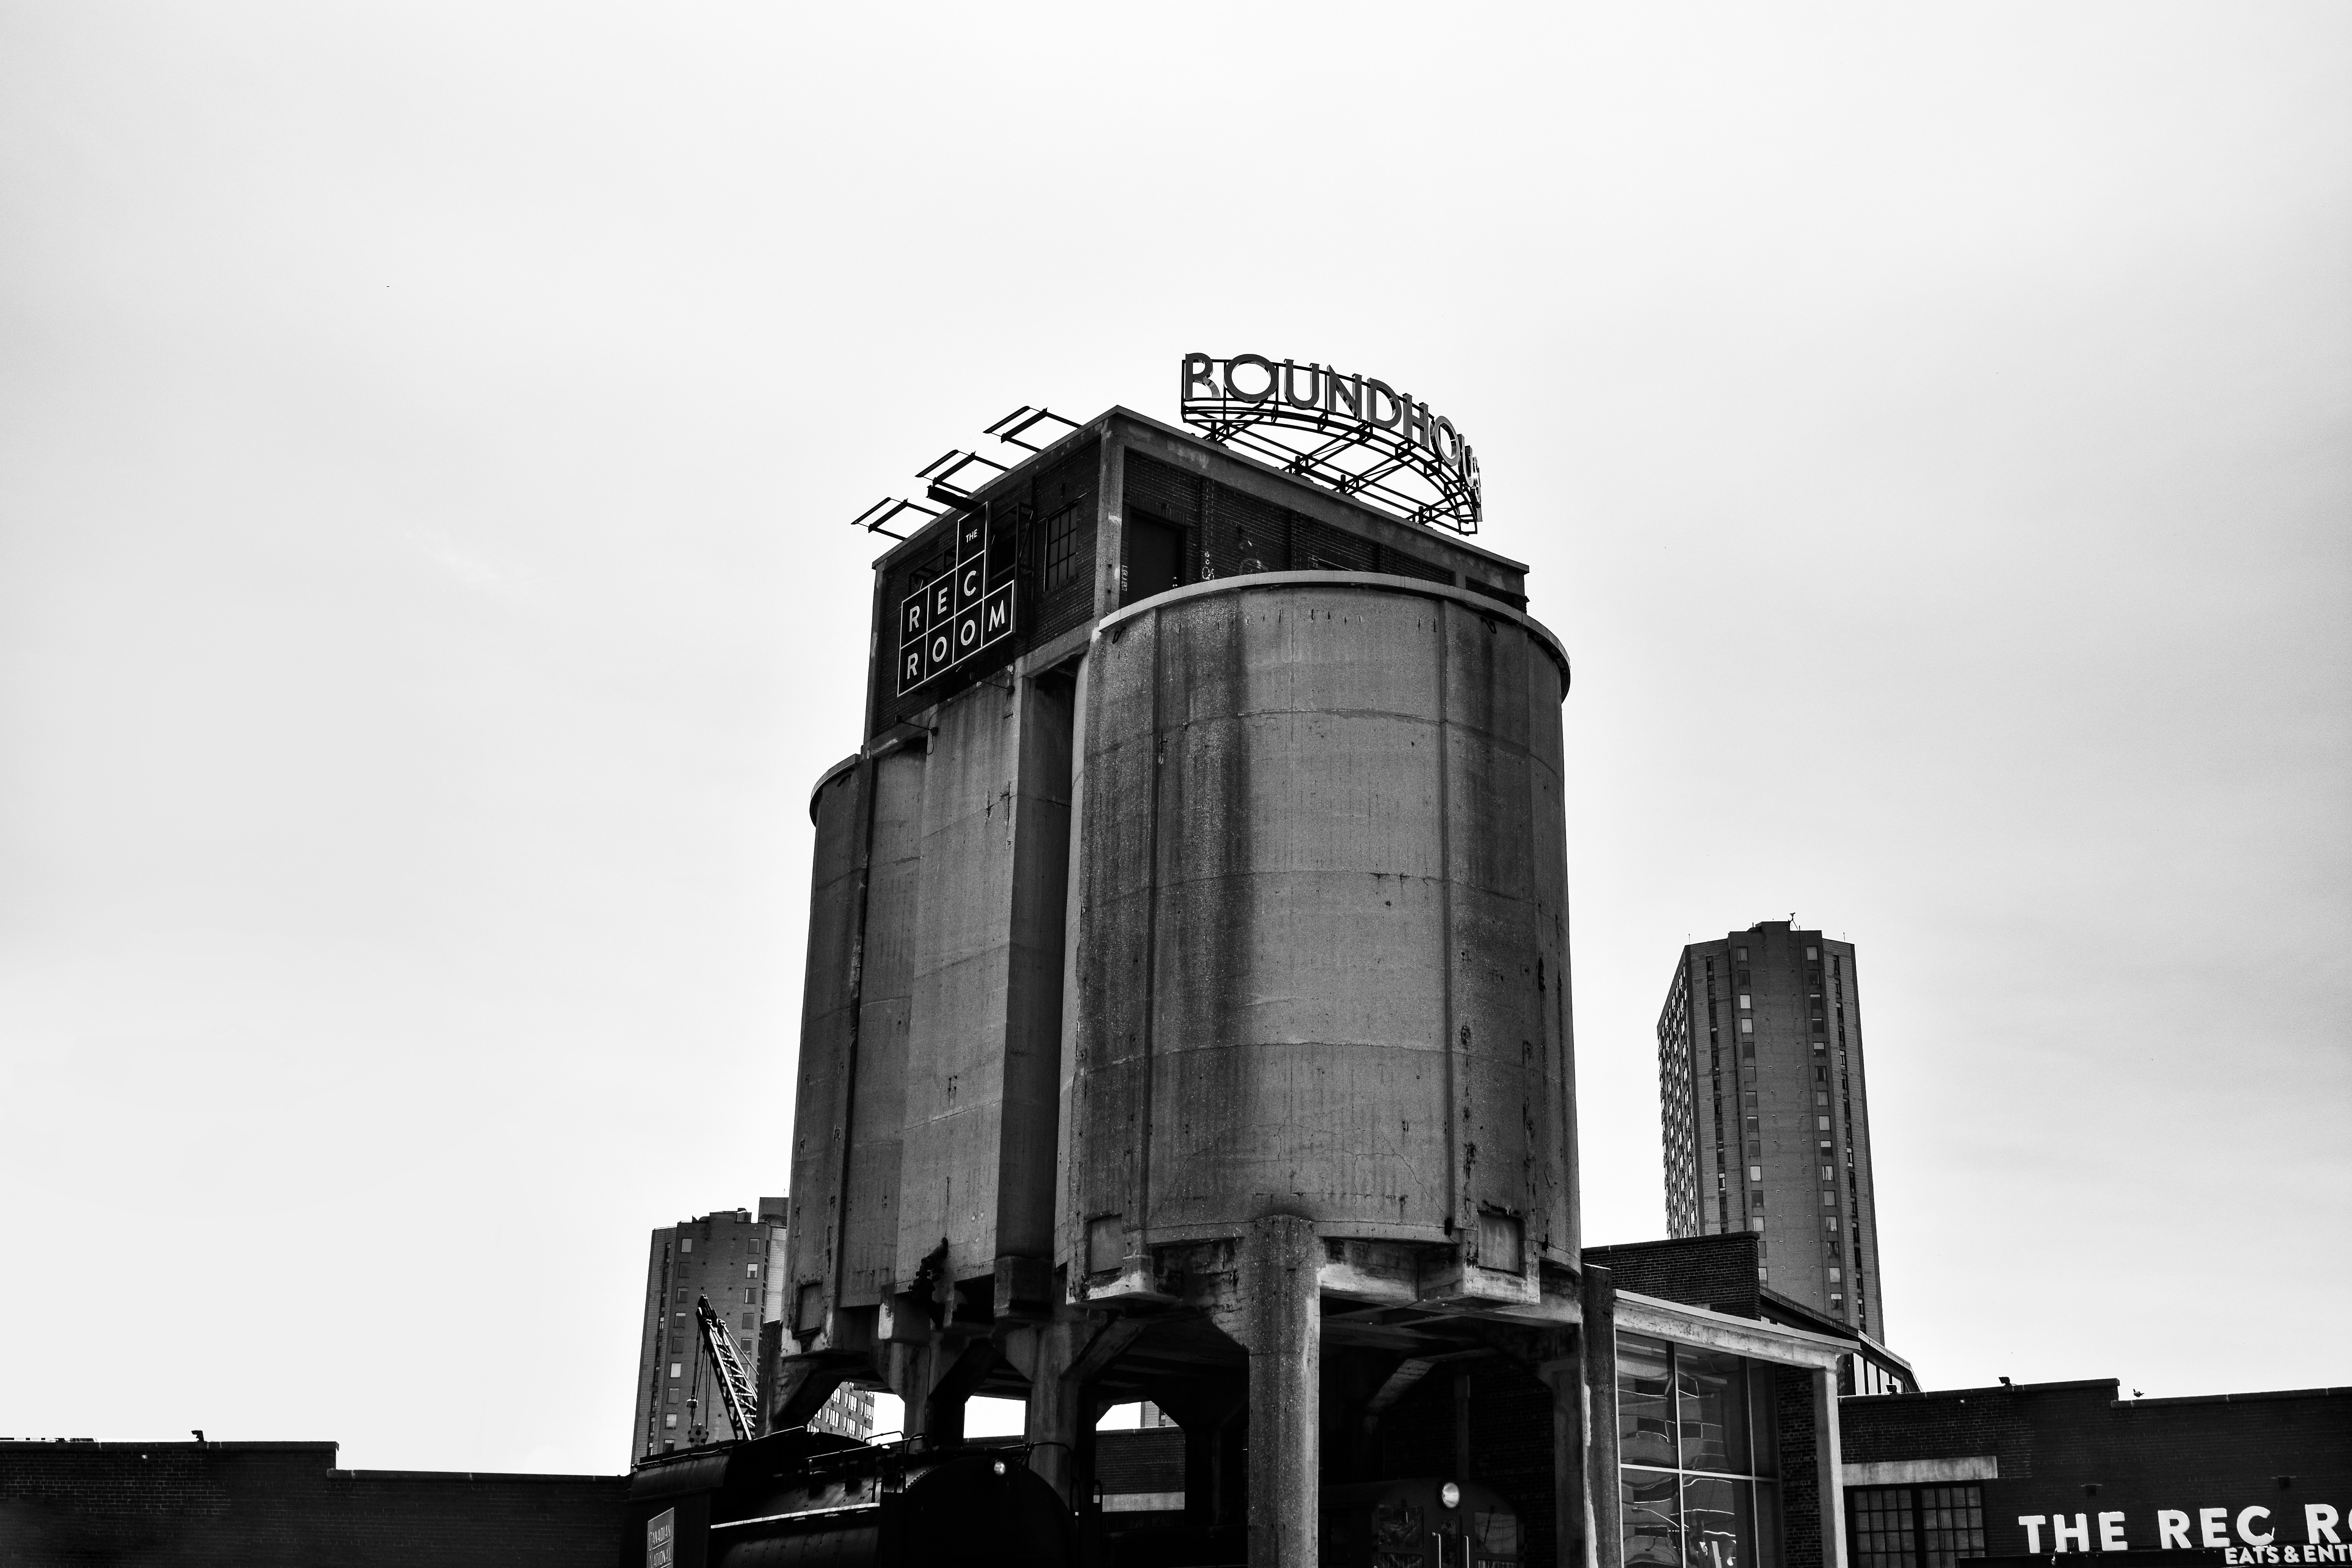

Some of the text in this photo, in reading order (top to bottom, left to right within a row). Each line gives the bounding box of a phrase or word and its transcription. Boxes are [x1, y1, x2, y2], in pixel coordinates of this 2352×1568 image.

[1185, 352, 1483, 522] ROUNDHOU
[966, 529, 978, 543] THE
[909, 570, 976, 632] REC
[907, 600, 1005, 679] ROOM
[649, 1524, 671, 1551] CANADIAN
[2018, 1504, 2352, 1553] THE REC R
[650, 1547, 671, 1568] NATIONAL
[2225, 1546, 2280, 1565] EATS
[2284, 1546, 2300, 1563] &
